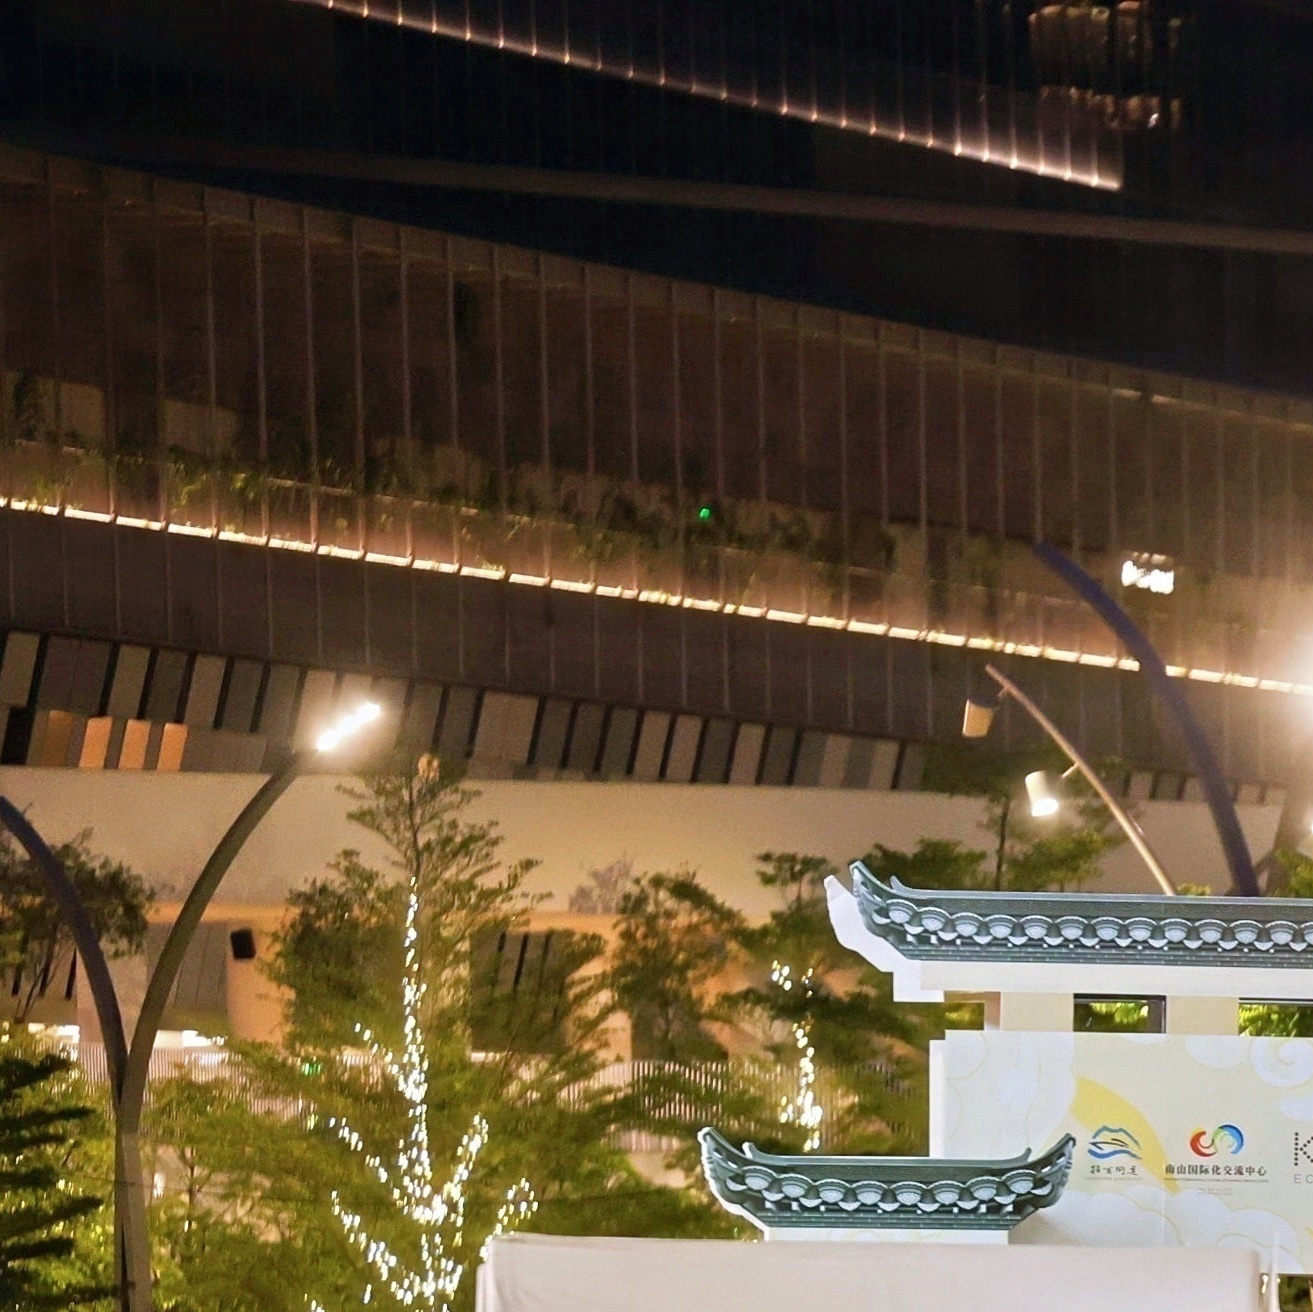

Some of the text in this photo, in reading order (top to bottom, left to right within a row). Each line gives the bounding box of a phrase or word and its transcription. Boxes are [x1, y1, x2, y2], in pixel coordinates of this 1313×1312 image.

[1165, 1163, 1268, 1177] 南山国际化交流中心
